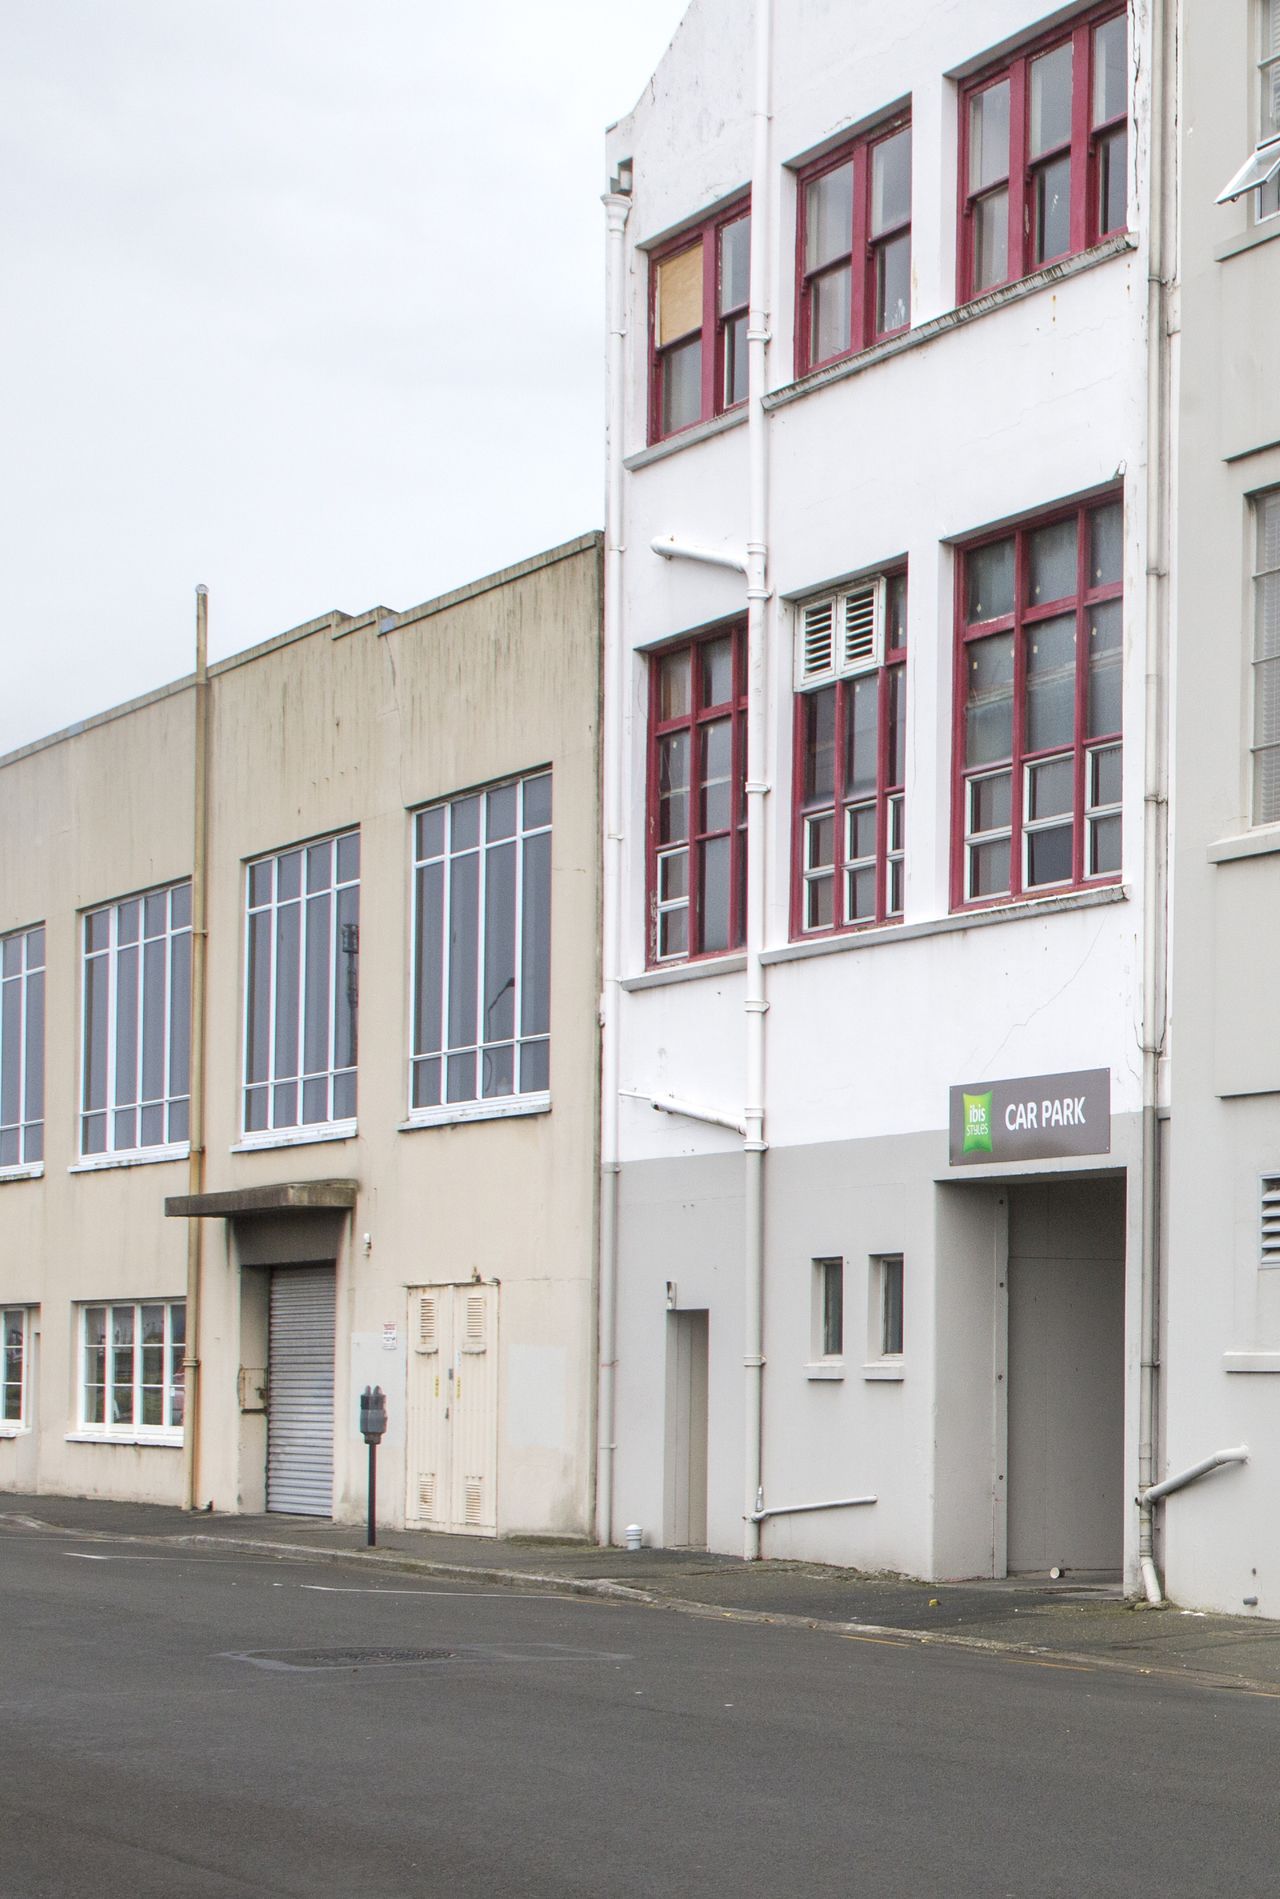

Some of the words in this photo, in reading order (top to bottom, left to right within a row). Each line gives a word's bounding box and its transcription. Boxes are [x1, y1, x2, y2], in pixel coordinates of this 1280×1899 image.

[970, 1103, 986, 1123] ibis
[1005, 1101, 1038, 1131] CAR
[1041, 1096, 1086, 1128] PARK
